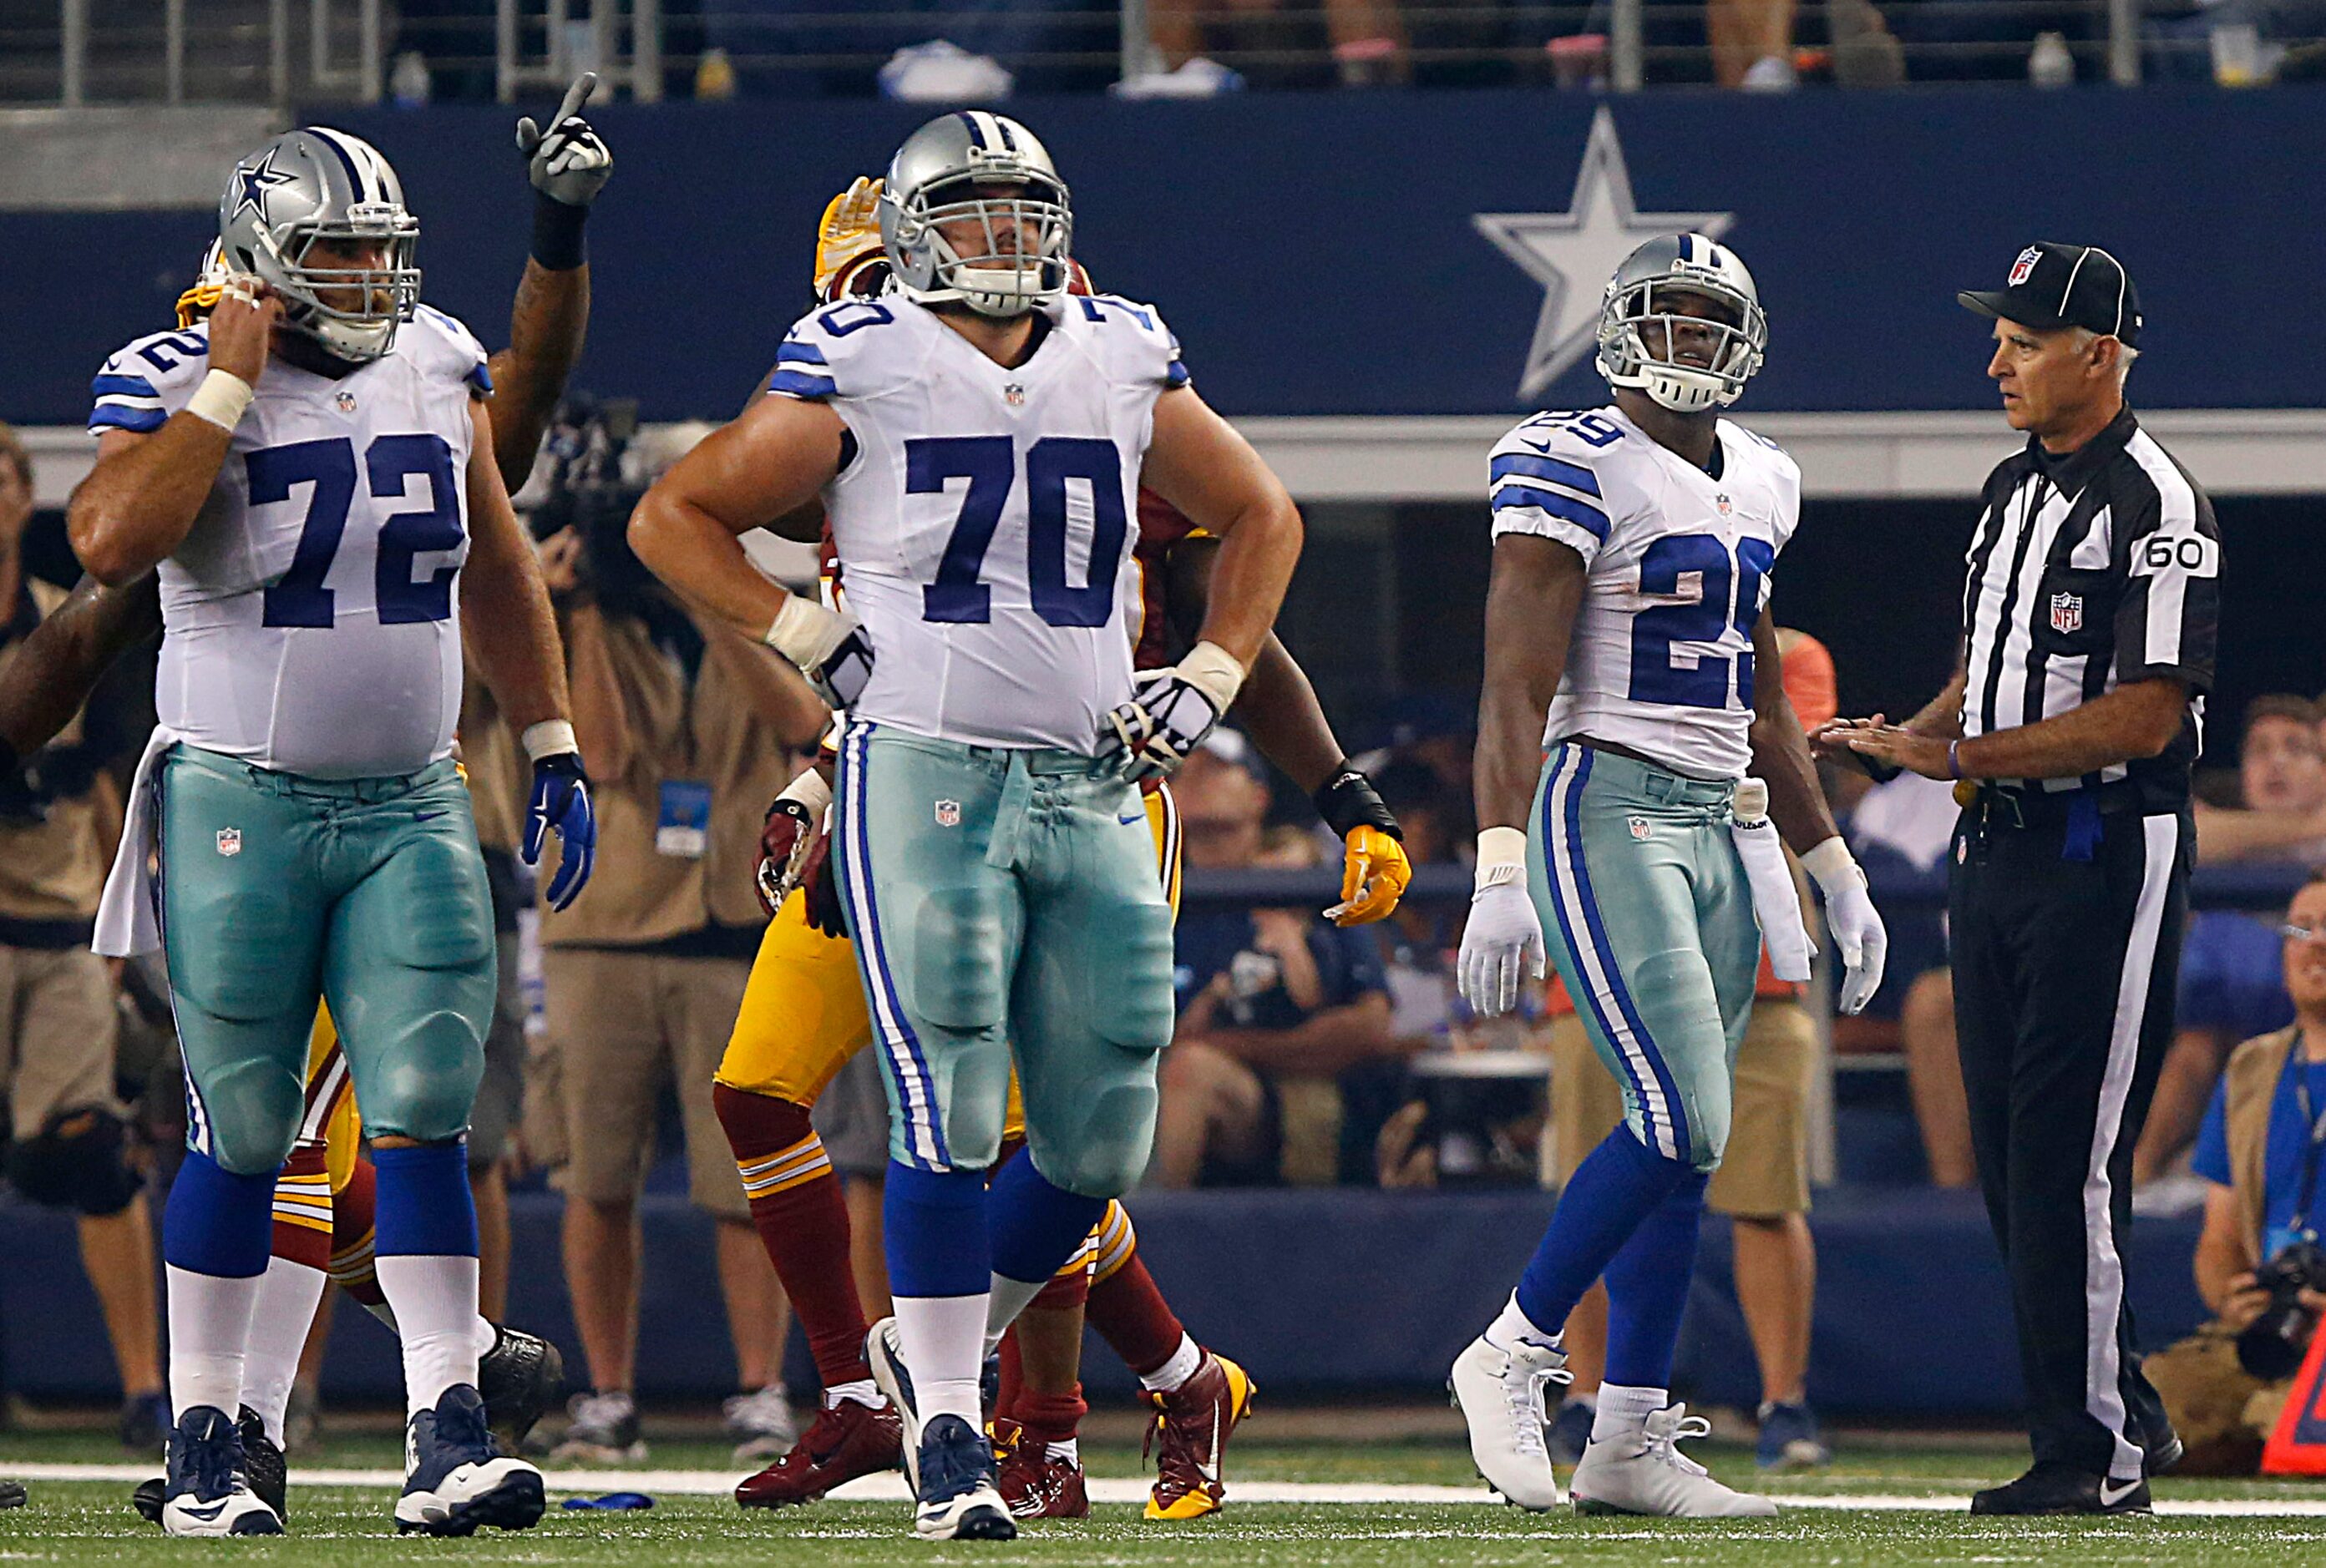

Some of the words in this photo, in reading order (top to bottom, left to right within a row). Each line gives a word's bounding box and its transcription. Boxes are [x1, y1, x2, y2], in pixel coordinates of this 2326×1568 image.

[246, 432, 464, 628] 72
[904, 436, 1127, 627] 70
[2146, 536, 2203, 569] 60
[2054, 609, 2080, 628] NFL
